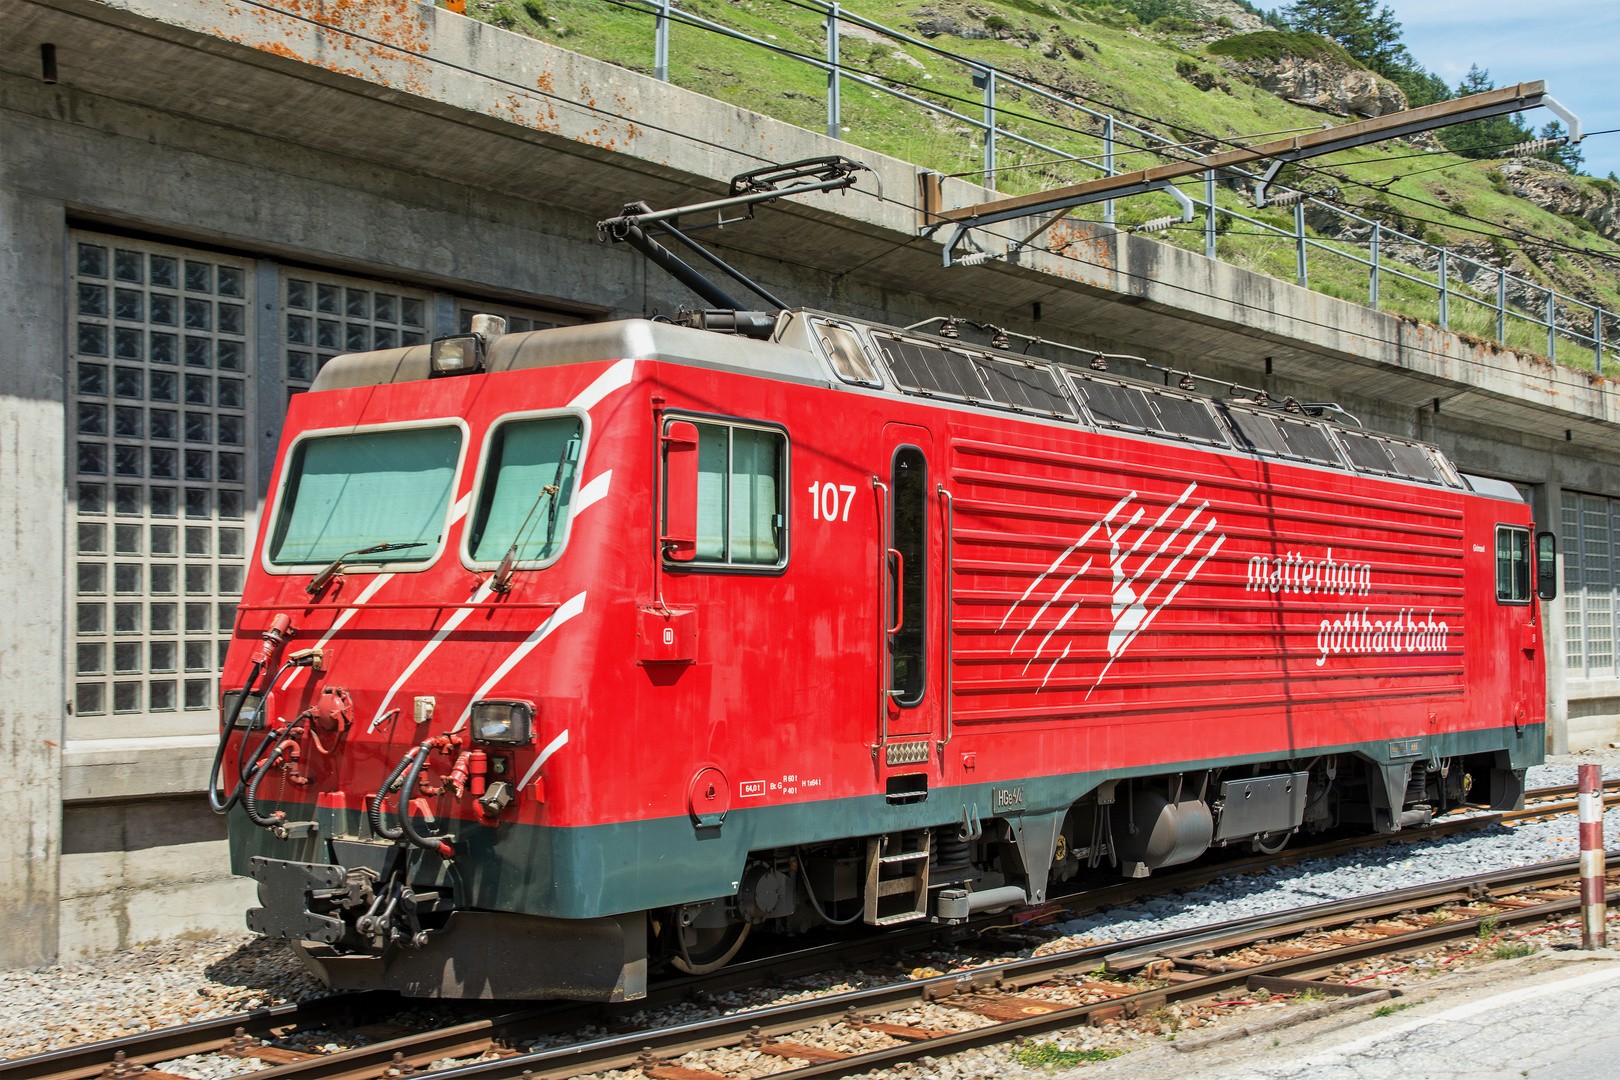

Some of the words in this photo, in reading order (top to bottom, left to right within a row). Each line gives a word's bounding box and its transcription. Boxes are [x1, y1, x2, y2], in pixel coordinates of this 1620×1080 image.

[808, 480, 856, 522] 107
[1246, 547, 1371, 597] matterhorn
[782, 775, 788, 783] R
[745, 784, 757, 793] 64,0
[777, 781, 783, 789] G
[782, 787, 787, 795] P
